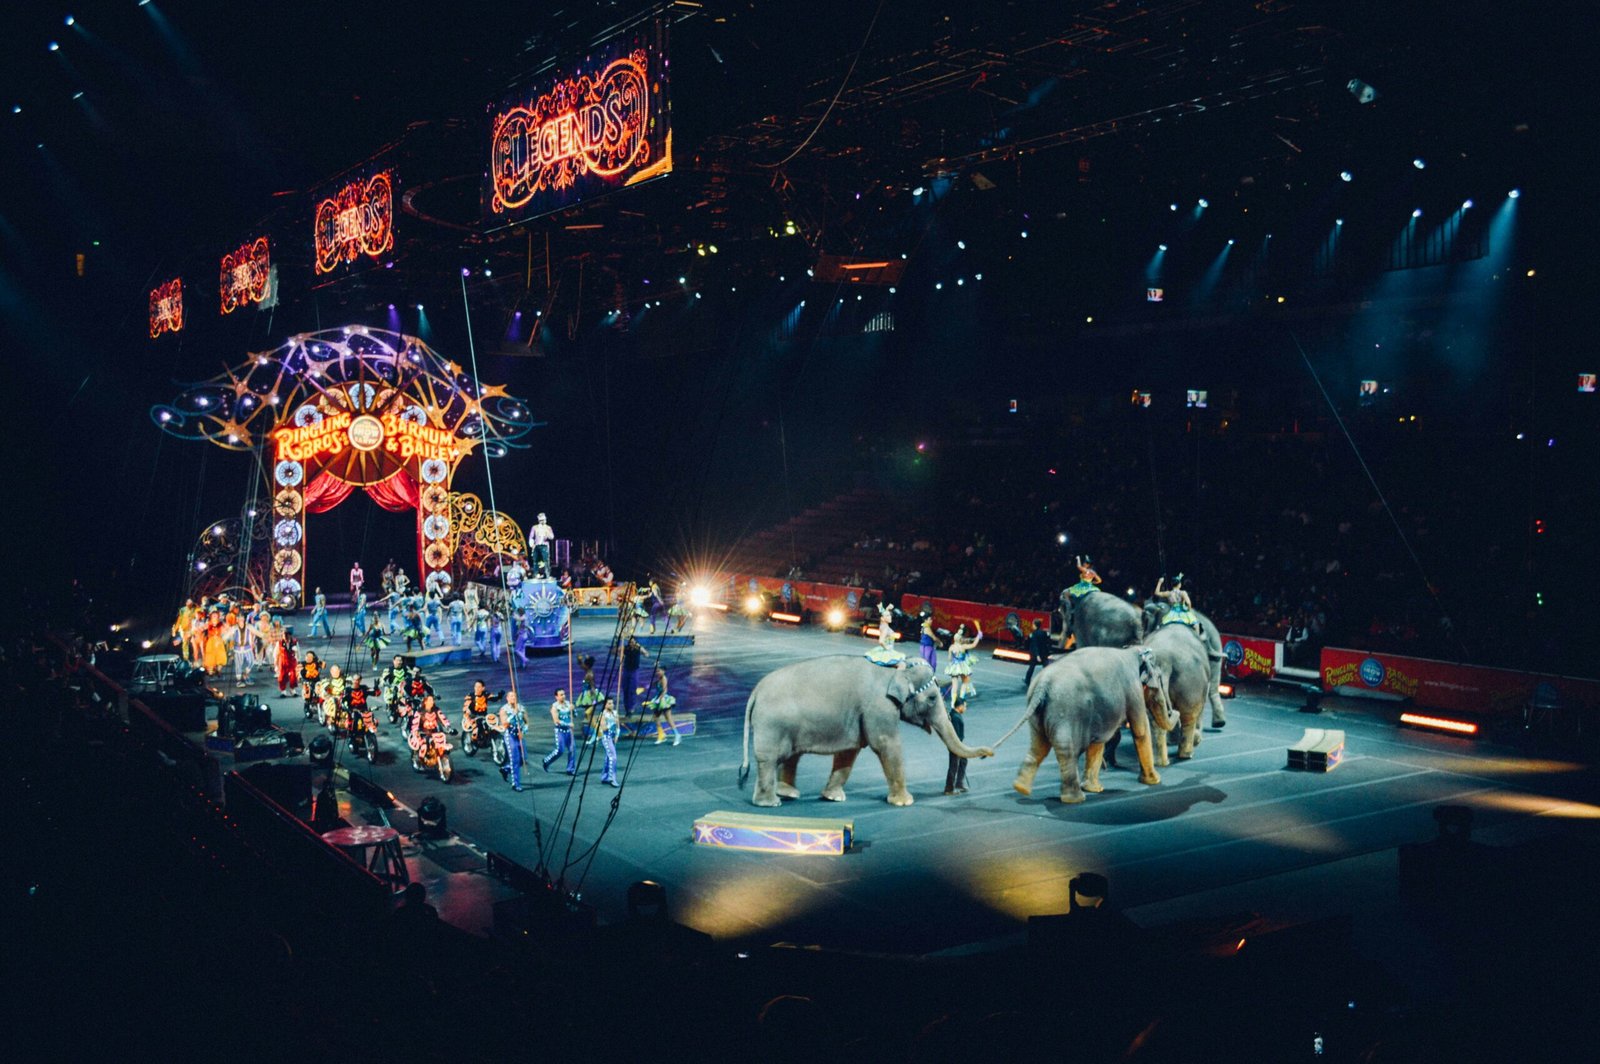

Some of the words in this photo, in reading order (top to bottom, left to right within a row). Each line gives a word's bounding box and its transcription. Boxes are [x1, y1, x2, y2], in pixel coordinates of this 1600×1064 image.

[511, 91, 625, 182] LEGENDS
[275, 412, 351, 461] RINGLING
[381, 413, 453, 446] BARNUM
[385, 437, 399, 453] &
[399, 435, 459, 461] BAILEY
